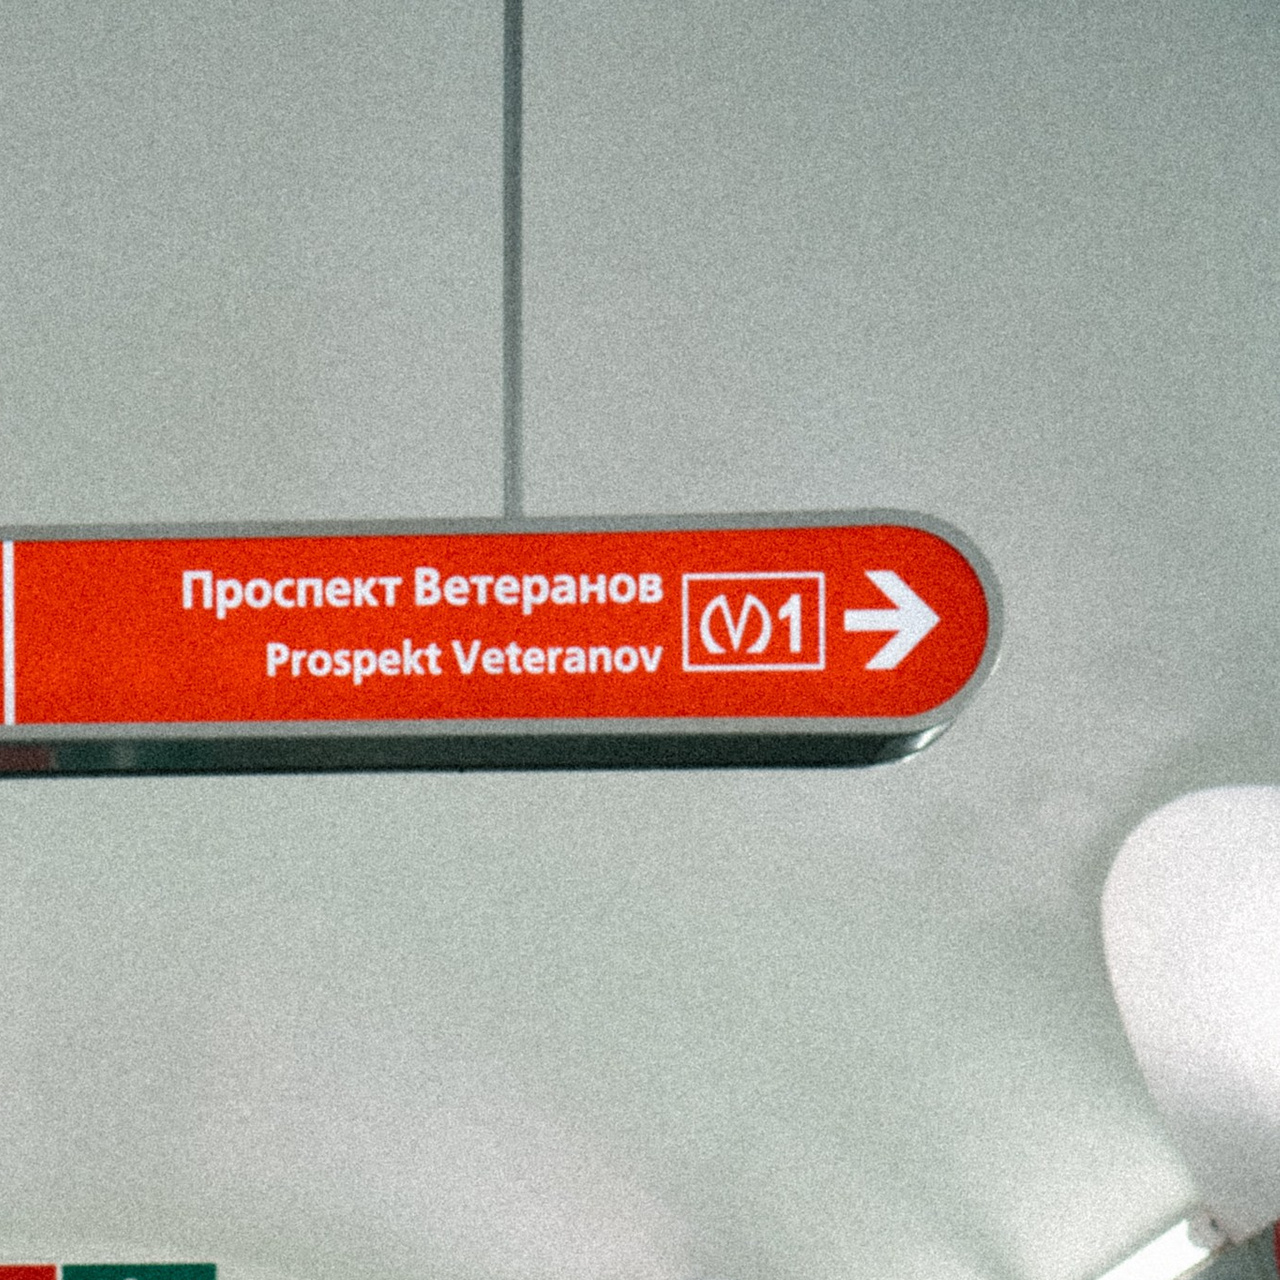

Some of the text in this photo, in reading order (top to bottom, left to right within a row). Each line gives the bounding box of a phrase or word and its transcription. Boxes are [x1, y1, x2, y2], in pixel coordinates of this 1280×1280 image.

[182, 566, 664, 620] Проспект Ветеранов
[265, 638, 663, 685] Prospekt Veteranov
